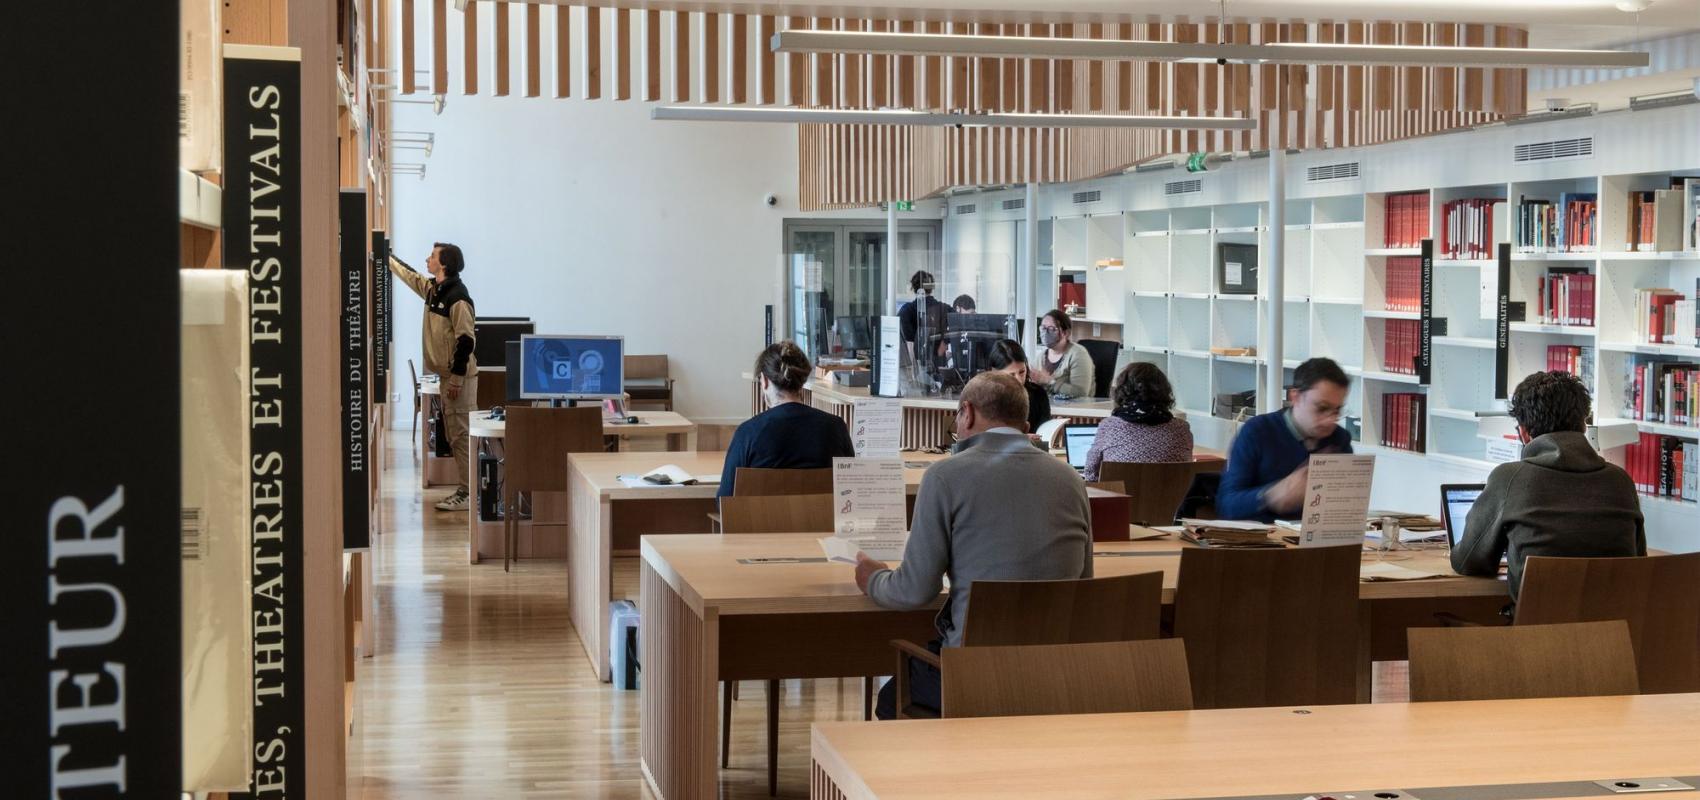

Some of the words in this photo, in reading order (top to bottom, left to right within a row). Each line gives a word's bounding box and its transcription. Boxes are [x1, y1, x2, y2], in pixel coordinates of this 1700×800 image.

[249, 84, 282, 344] FESTIVALS
[347, 270, 361, 350] THÉÂTRE
[375, 258, 384, 315] DRAMATIQUE
[1423, 258, 1431, 305] INVENTAIRES
[1423, 308, 1430, 318] ET
[349, 358, 362, 382] DU
[375, 318, 384, 376] LITTÉRATURE
[251, 367, 283, 429] ET
[350, 390, 363, 472] HISTOIRE
[48, 484, 127, 800] TEUR
[254, 726, 291, 800] ES,
